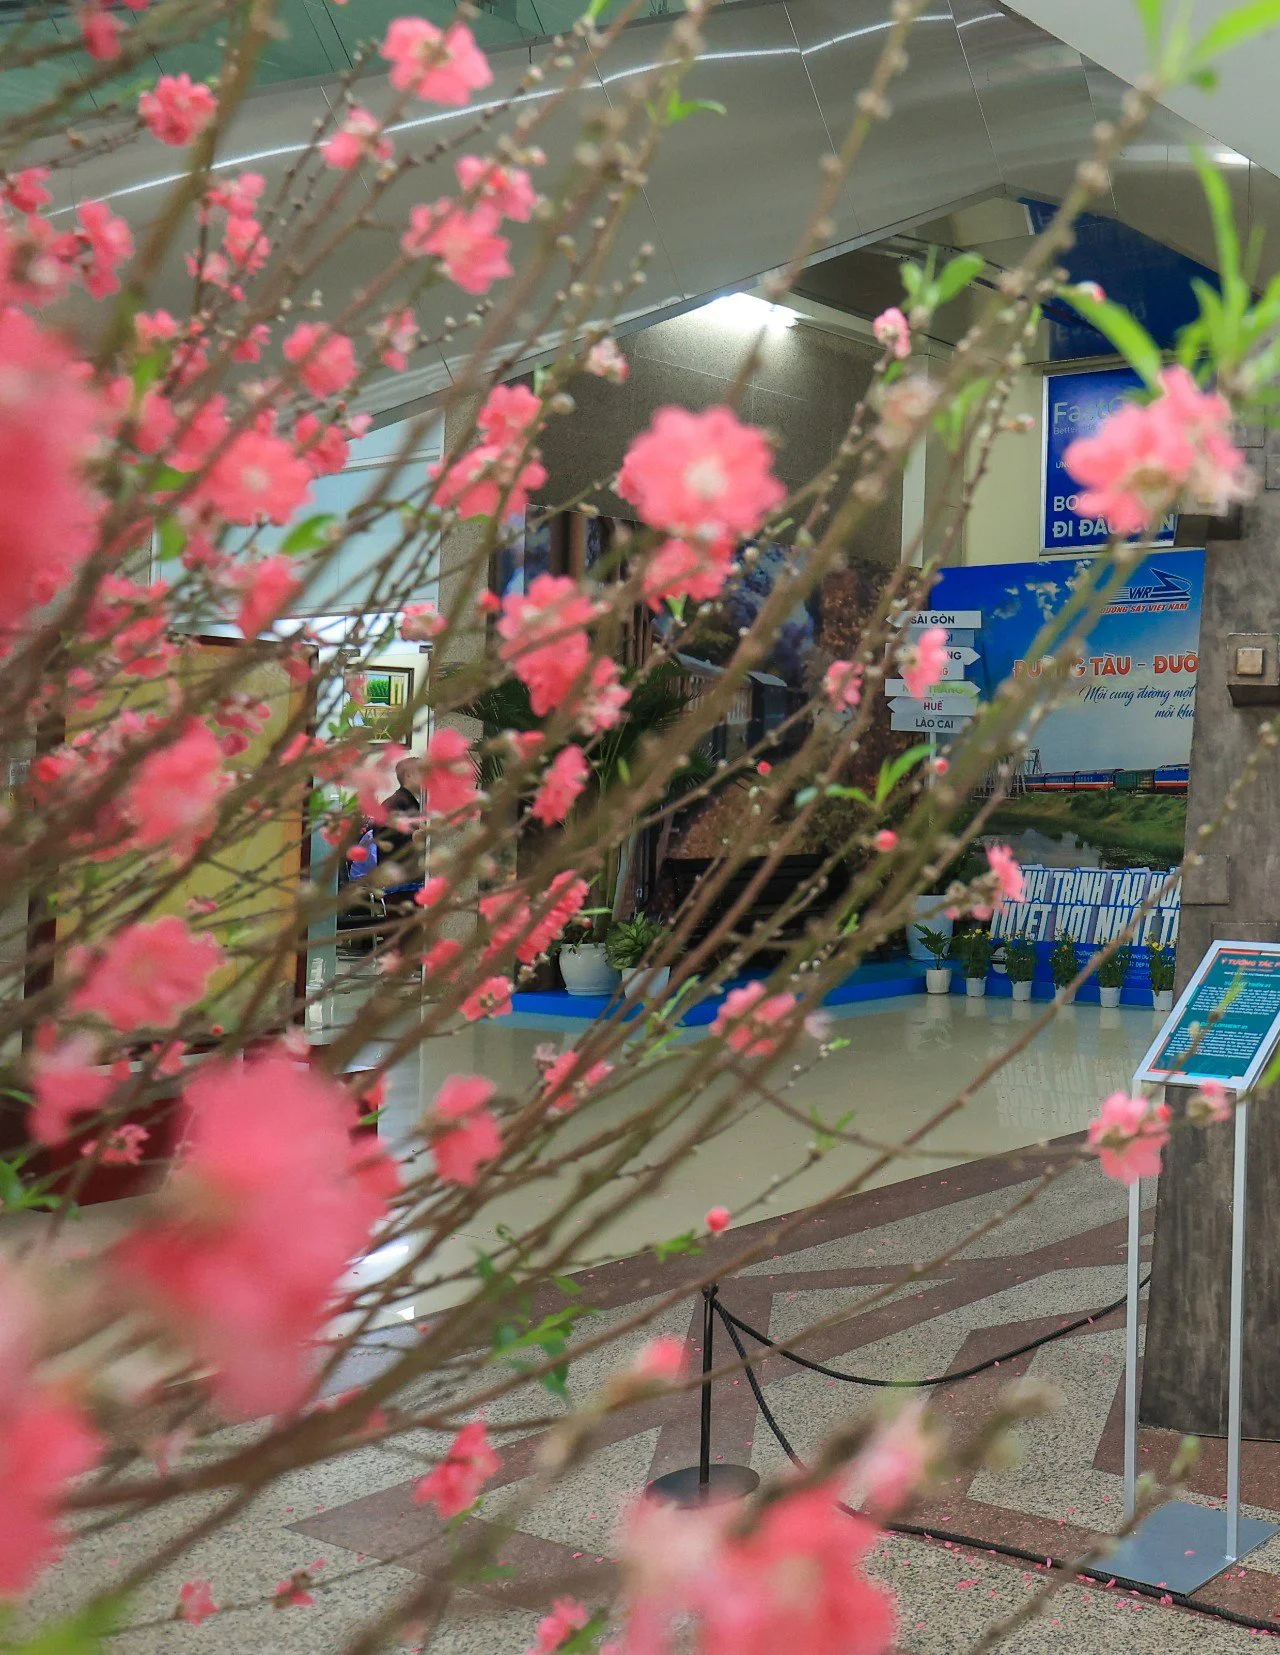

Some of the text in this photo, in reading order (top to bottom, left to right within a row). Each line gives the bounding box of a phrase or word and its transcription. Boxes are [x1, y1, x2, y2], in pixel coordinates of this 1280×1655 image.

[1052, 520, 1073, 538] ĐI
[1128, 587, 1153, 600] VNR
[1167, 602, 1188, 611] NAM
[911, 613, 955, 625] SÀI GÒN
[1090, 652, 1131, 676] TÀU
[1109, 690, 1134, 707] cung
[1137, 685, 1171, 706] đường
[923, 699, 944, 711] HUẾ
[915, 716, 954, 729] LÀO CAI
[1051, 866, 1146, 905] TRÌNH TÀU
